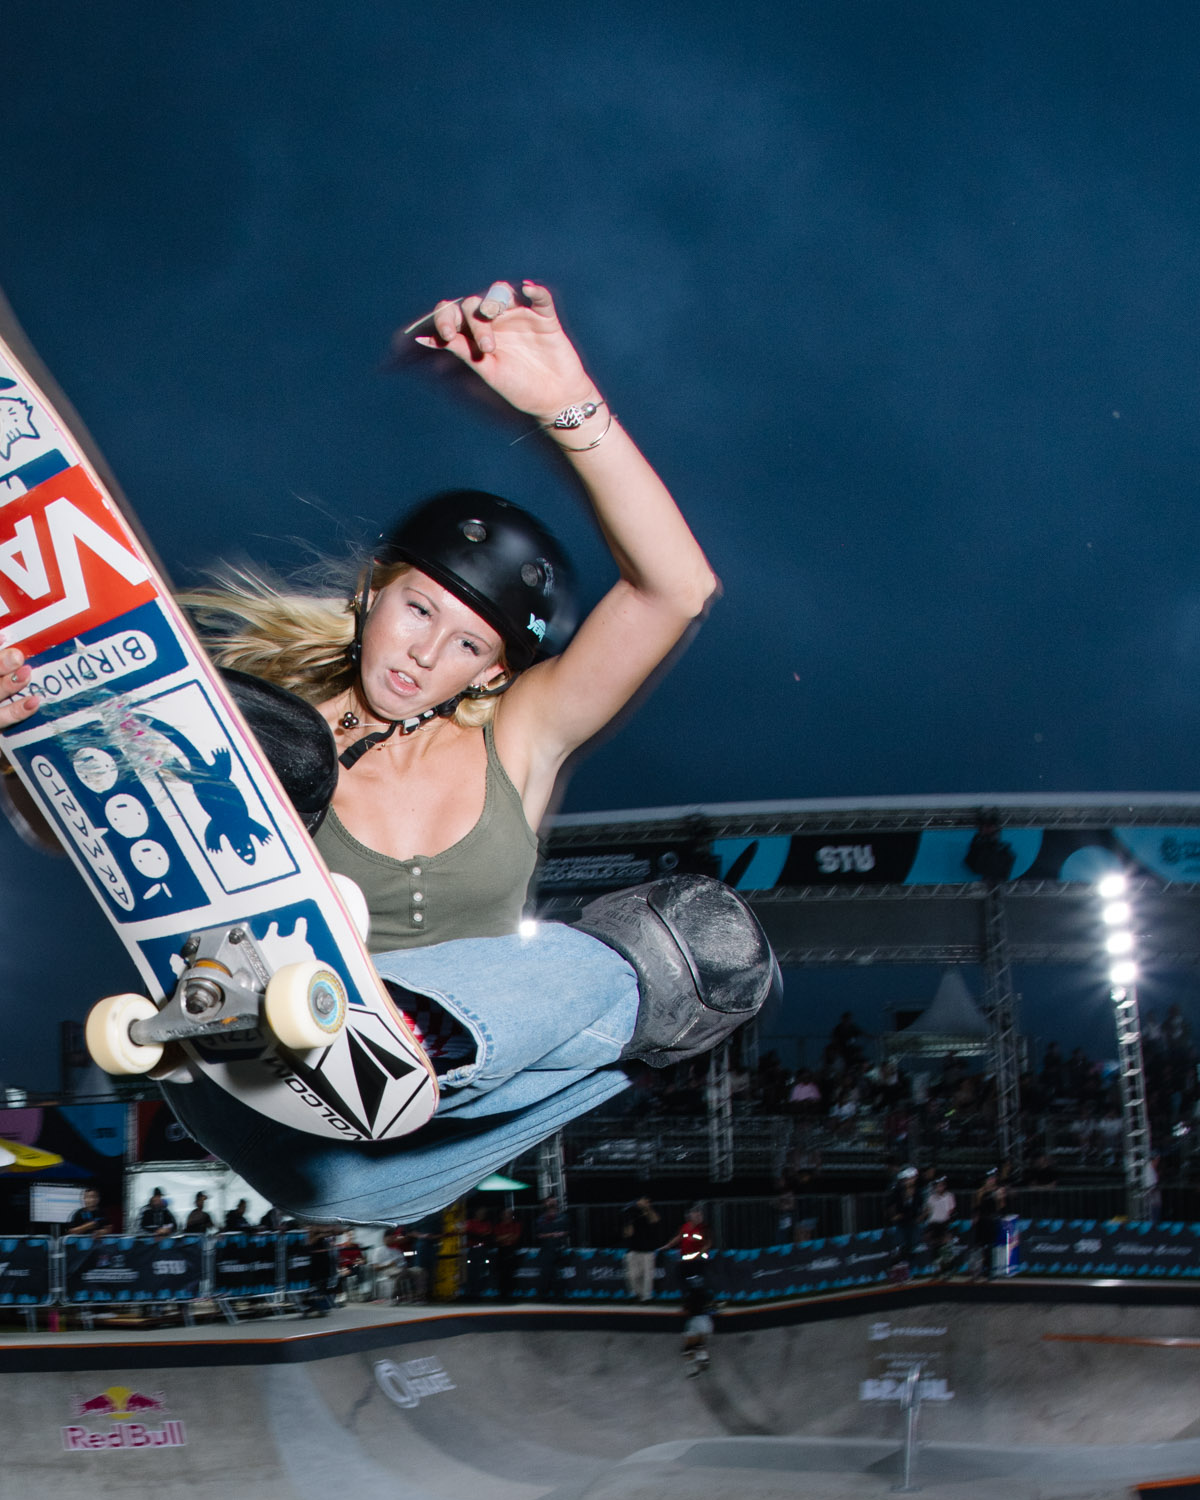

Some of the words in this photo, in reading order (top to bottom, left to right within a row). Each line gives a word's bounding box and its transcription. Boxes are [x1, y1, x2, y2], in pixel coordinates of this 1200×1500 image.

[8, 637, 146, 700] BIRDHOU
[37, 761, 130, 905] ARMANTO
[815, 844, 875, 873] STU
[264, 1056, 362, 1140] VOLCOM
[62, 1423, 123, 1451] Red
[124, 1420, 185, 1449] Bull
